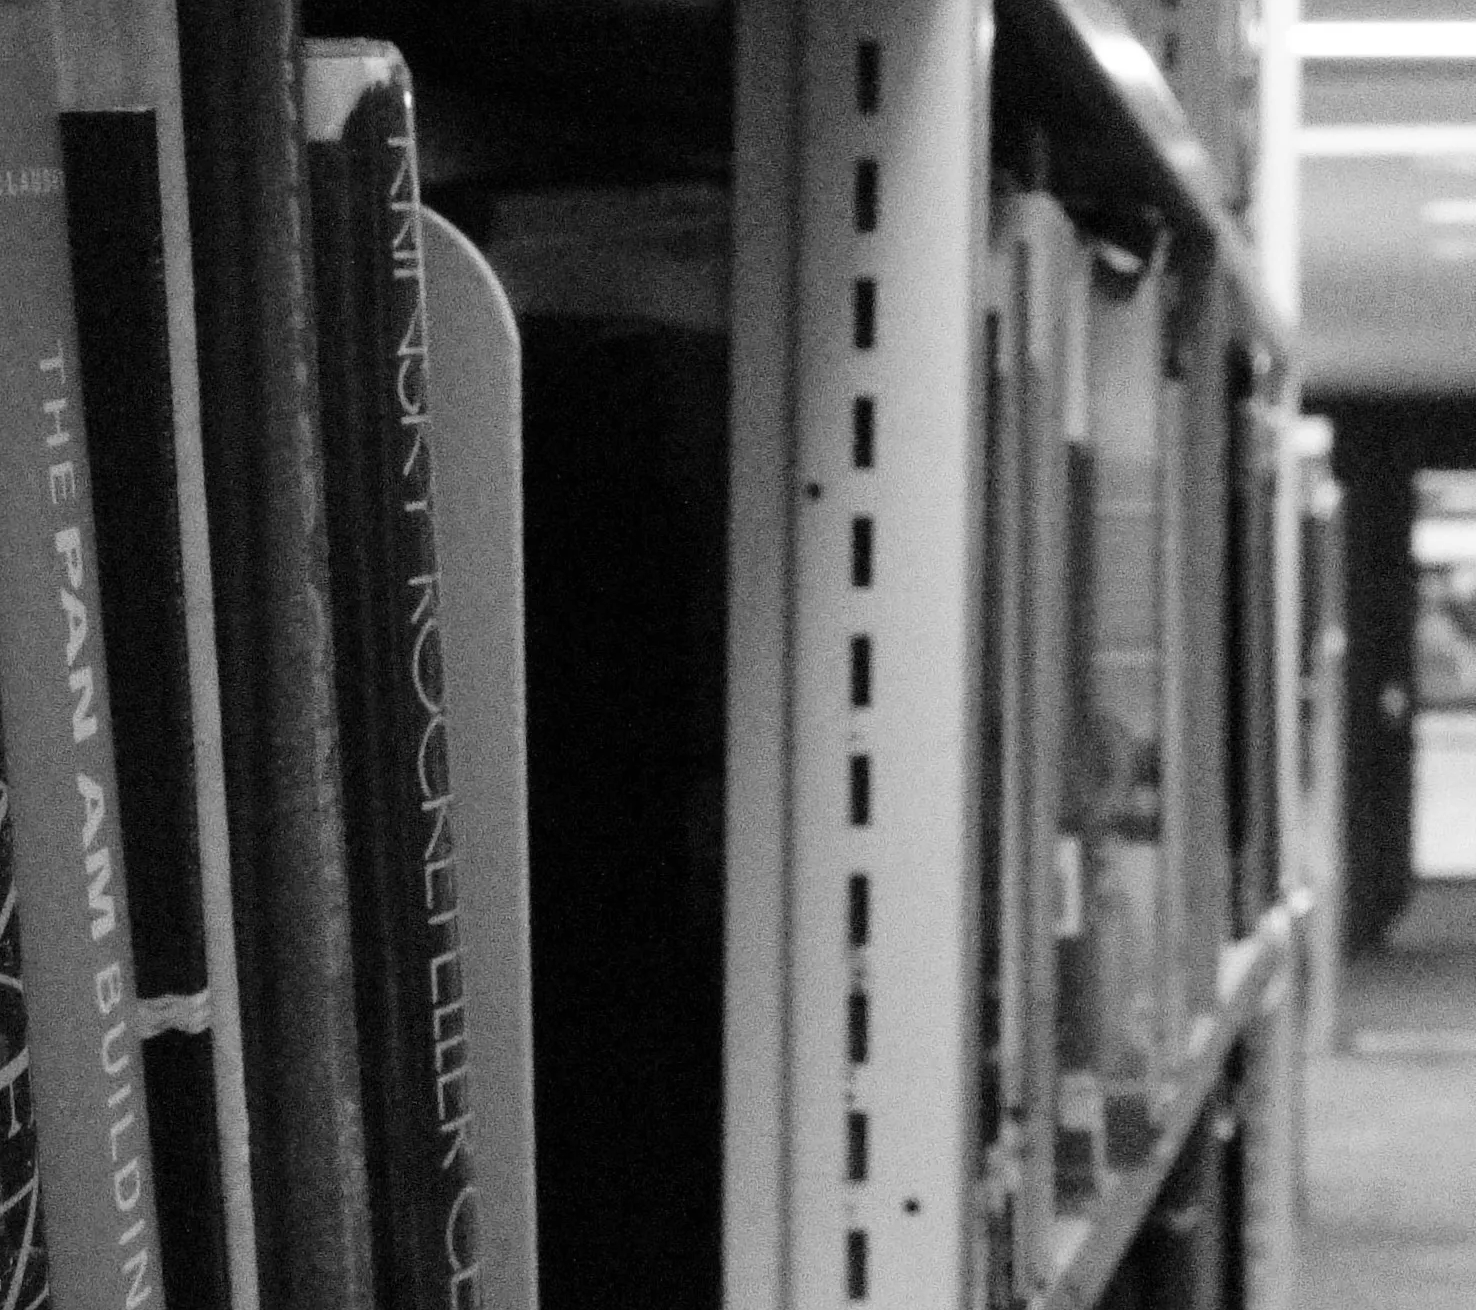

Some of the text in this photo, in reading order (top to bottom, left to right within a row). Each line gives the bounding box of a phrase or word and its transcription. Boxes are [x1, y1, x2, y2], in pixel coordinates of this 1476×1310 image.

[36, 338, 78, 507] THE
[52, 525, 103, 745] PAN
[74, 771, 121, 942] AM
[408, 571, 481, 1173] ROCKEFELLER
